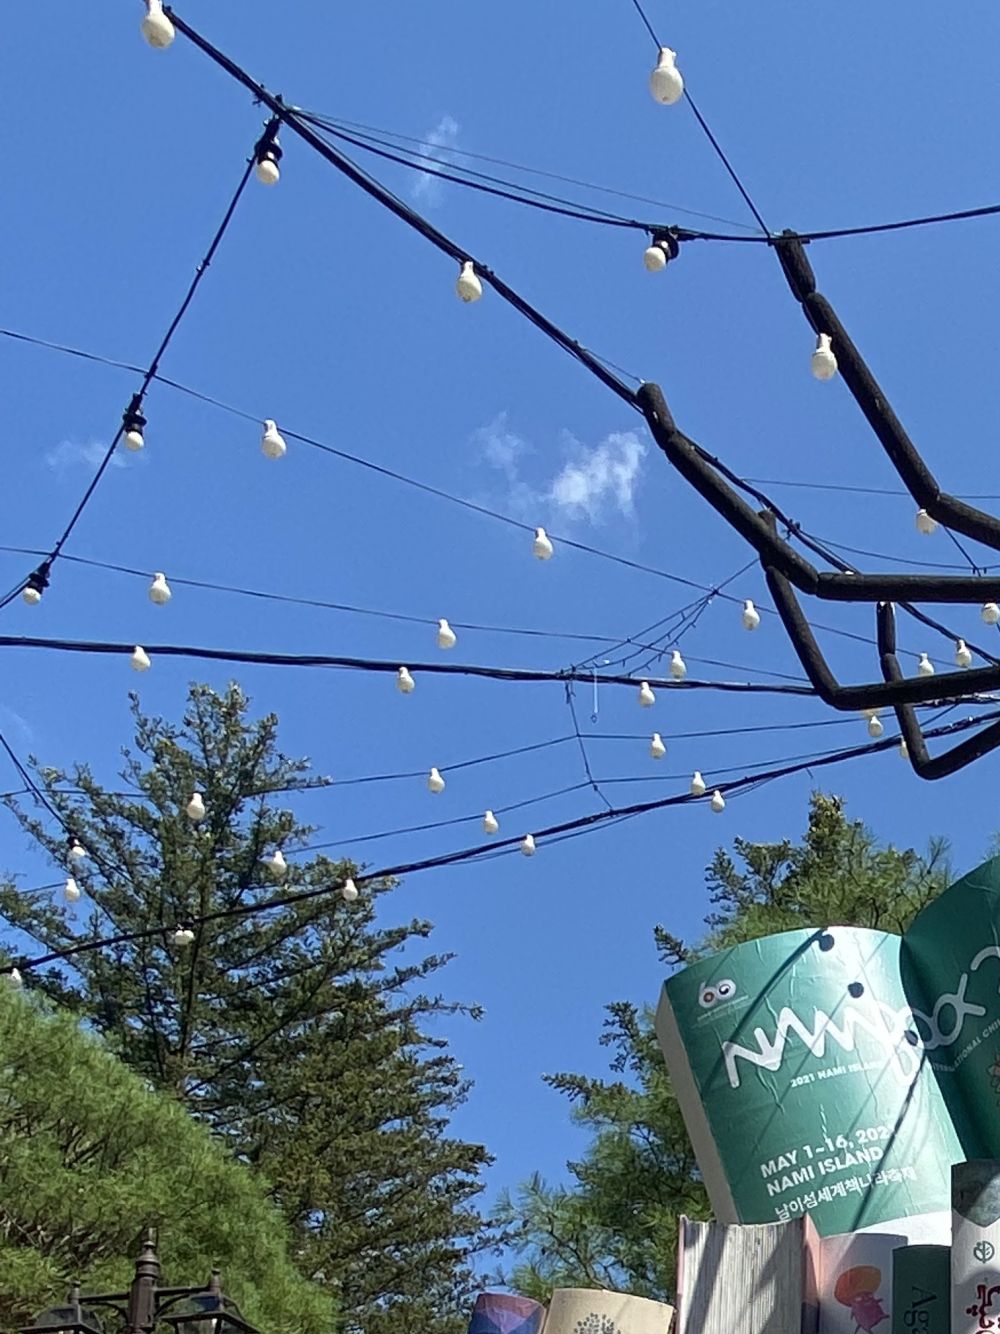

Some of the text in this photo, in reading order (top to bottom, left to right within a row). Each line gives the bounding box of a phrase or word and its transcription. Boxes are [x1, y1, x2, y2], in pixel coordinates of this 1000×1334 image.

[790, 1073, 815, 1088] 2021
[817, 1064, 847, 1080] NAMI
[760, 1150, 797, 1178] MAY
[766, 1146, 884, 1197] NAMI ISLAND
